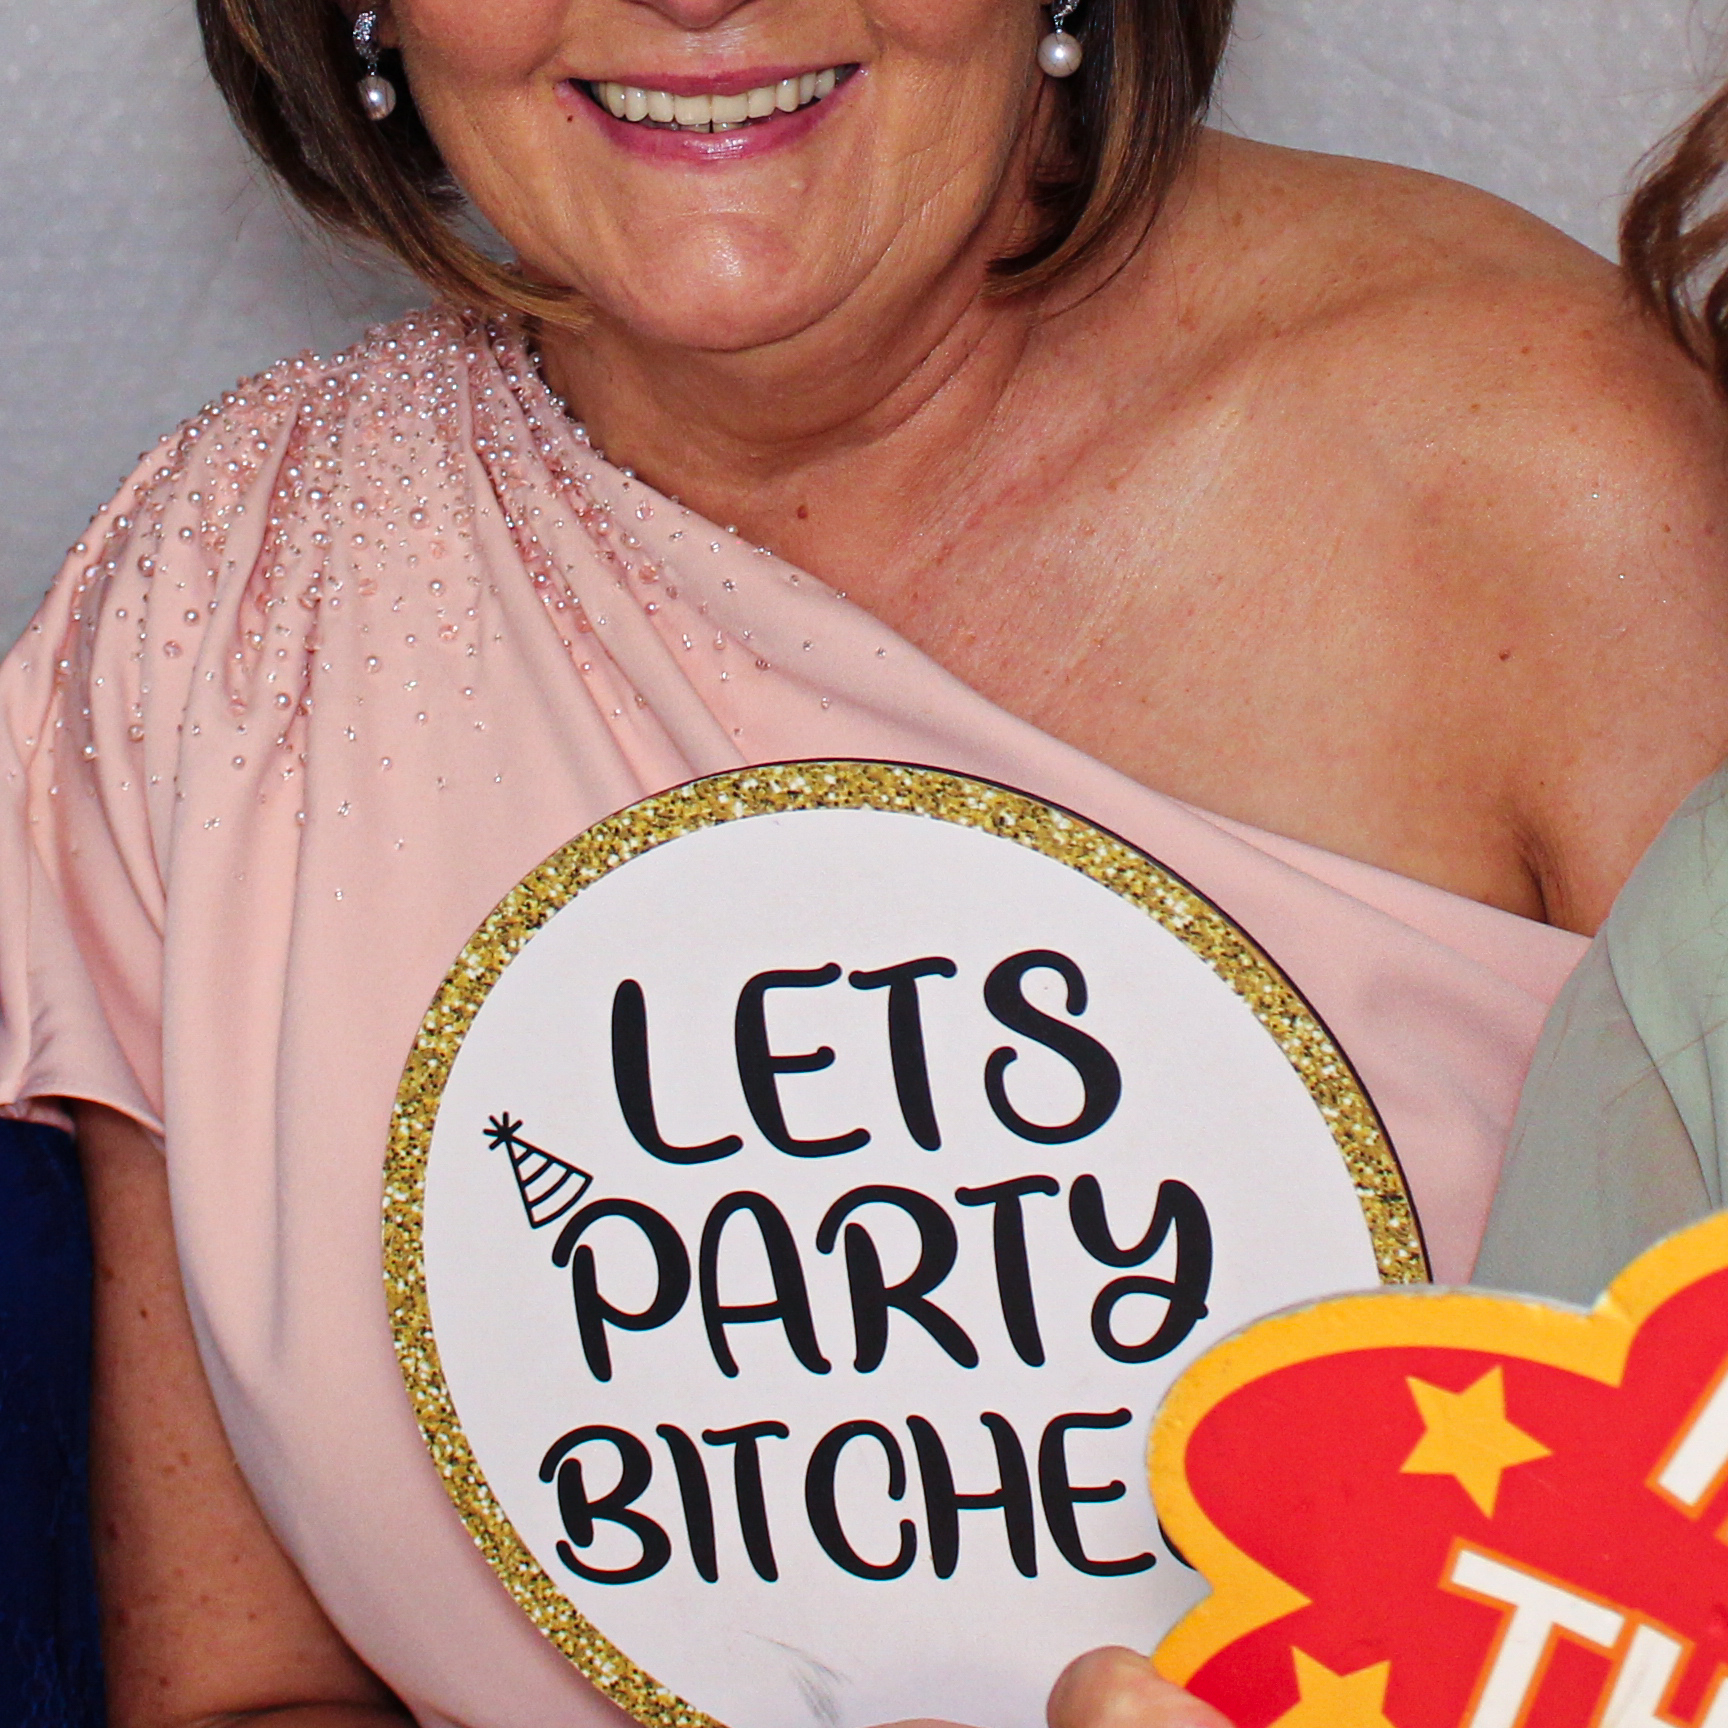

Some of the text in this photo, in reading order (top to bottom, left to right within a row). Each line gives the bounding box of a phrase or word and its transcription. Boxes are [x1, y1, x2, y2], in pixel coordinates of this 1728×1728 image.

[610, 948, 1123, 1166] LETS
[550, 1172, 1215, 1384] PARTY
[537, 1406, 1198, 1587] BITCHE
